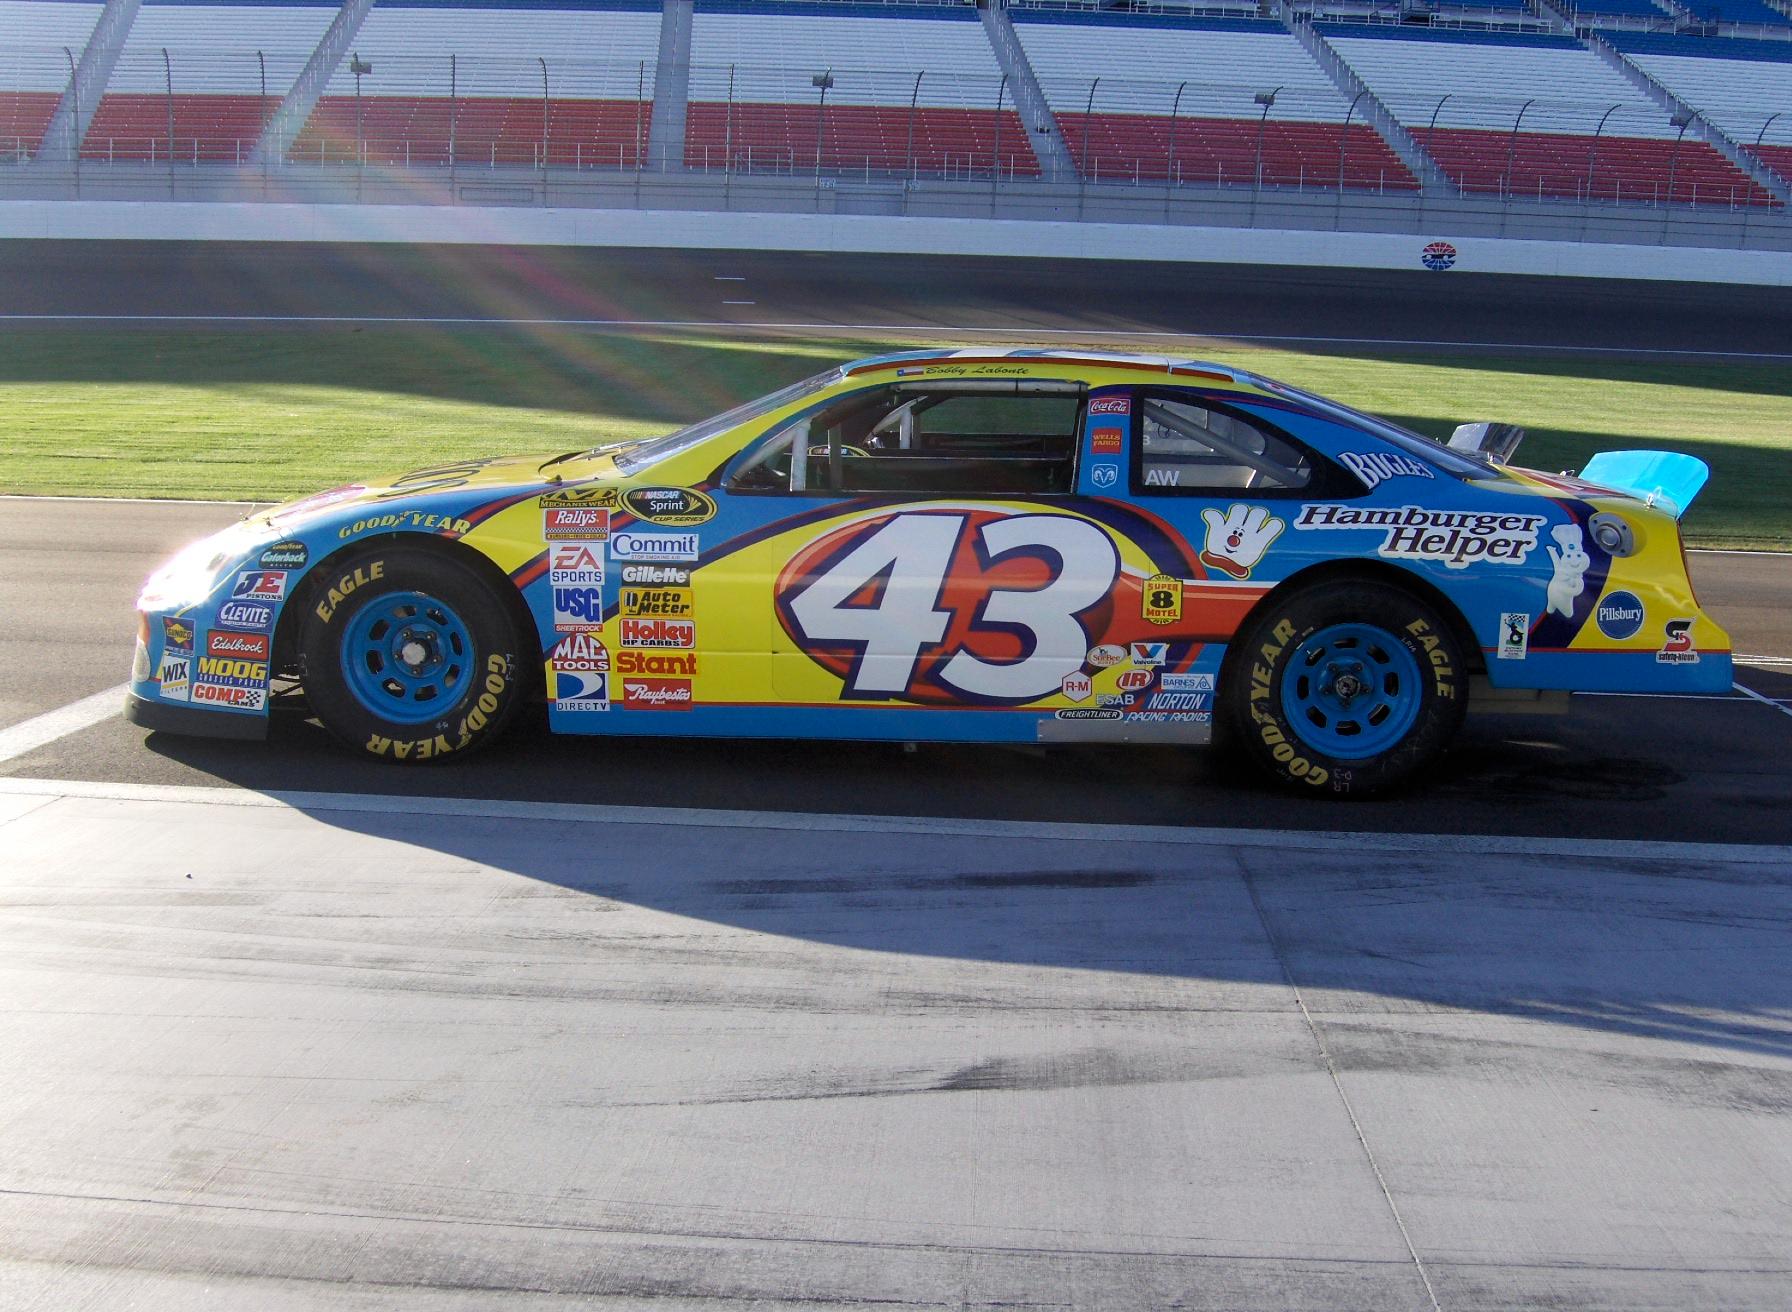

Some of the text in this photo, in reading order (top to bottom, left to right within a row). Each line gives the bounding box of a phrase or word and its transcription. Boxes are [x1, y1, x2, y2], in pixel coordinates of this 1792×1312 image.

[926, 366, 1029, 375] Bobby Labonte
[1338, 452, 1435, 489] BUGLES
[645, 490, 680, 499] NASCAR
[540, 499, 616, 508] MECHANIX WEAR
[650, 500, 684, 511] Sprint
[555, 510, 598, 526] Rally's
[1299, 506, 1541, 535] Hamburger
[612, 534, 696, 555] Commit
[1384, 527, 1531, 562] Helper
[554, 546, 601, 570] EA
[552, 572, 602, 583] SPORTS
[622, 566, 688, 583] Gillette
[315, 560, 385, 624] EAGLE
[1148, 583, 1178, 592] SUPER
[246, 593, 283, 601] PISTONS
[640, 592, 681, 603] Auto
[1150, 590, 1174, 608] 8
[220, 601, 269, 624] CLEVITE
[555, 588, 600, 622] USG
[637, 602, 690, 614] Meter
[789, 513, 1117, 699] 43
[1147, 607, 1178, 617] MOTEL
[1600, 607, 1642, 621] Pillsbury
[167, 628, 193, 640] SUNOCO
[623, 620, 693, 646] Holley
[212, 637, 264, 654] Edelbrock
[554, 633, 608, 659] MAC
[617, 651, 697, 674] Stant
[1406, 618, 1455, 700] EAGLE
[1658, 653, 1695, 662] safety-kleen
[163, 662, 187, 683] WIX
[198, 656, 267, 680] MOOG
[554, 661, 609, 670] TOOLS
[238, 679, 264, 688] PARTS
[1066, 681, 1089, 692] R-M
[1122, 672, 1147, 687] IR
[1163, 678, 1195, 687] BARNES
[195, 684, 246, 702] COMP
[624, 683, 691, 705] Raybestos
[1096, 695, 1134, 705] ESAB
[557, 702, 608, 711] DIRECTV
[1149, 693, 1206, 710] NORTON
[1060, 711, 1118, 719] FREIGHTLINER
[1126, 712, 1211, 722] RACING RADIOS
